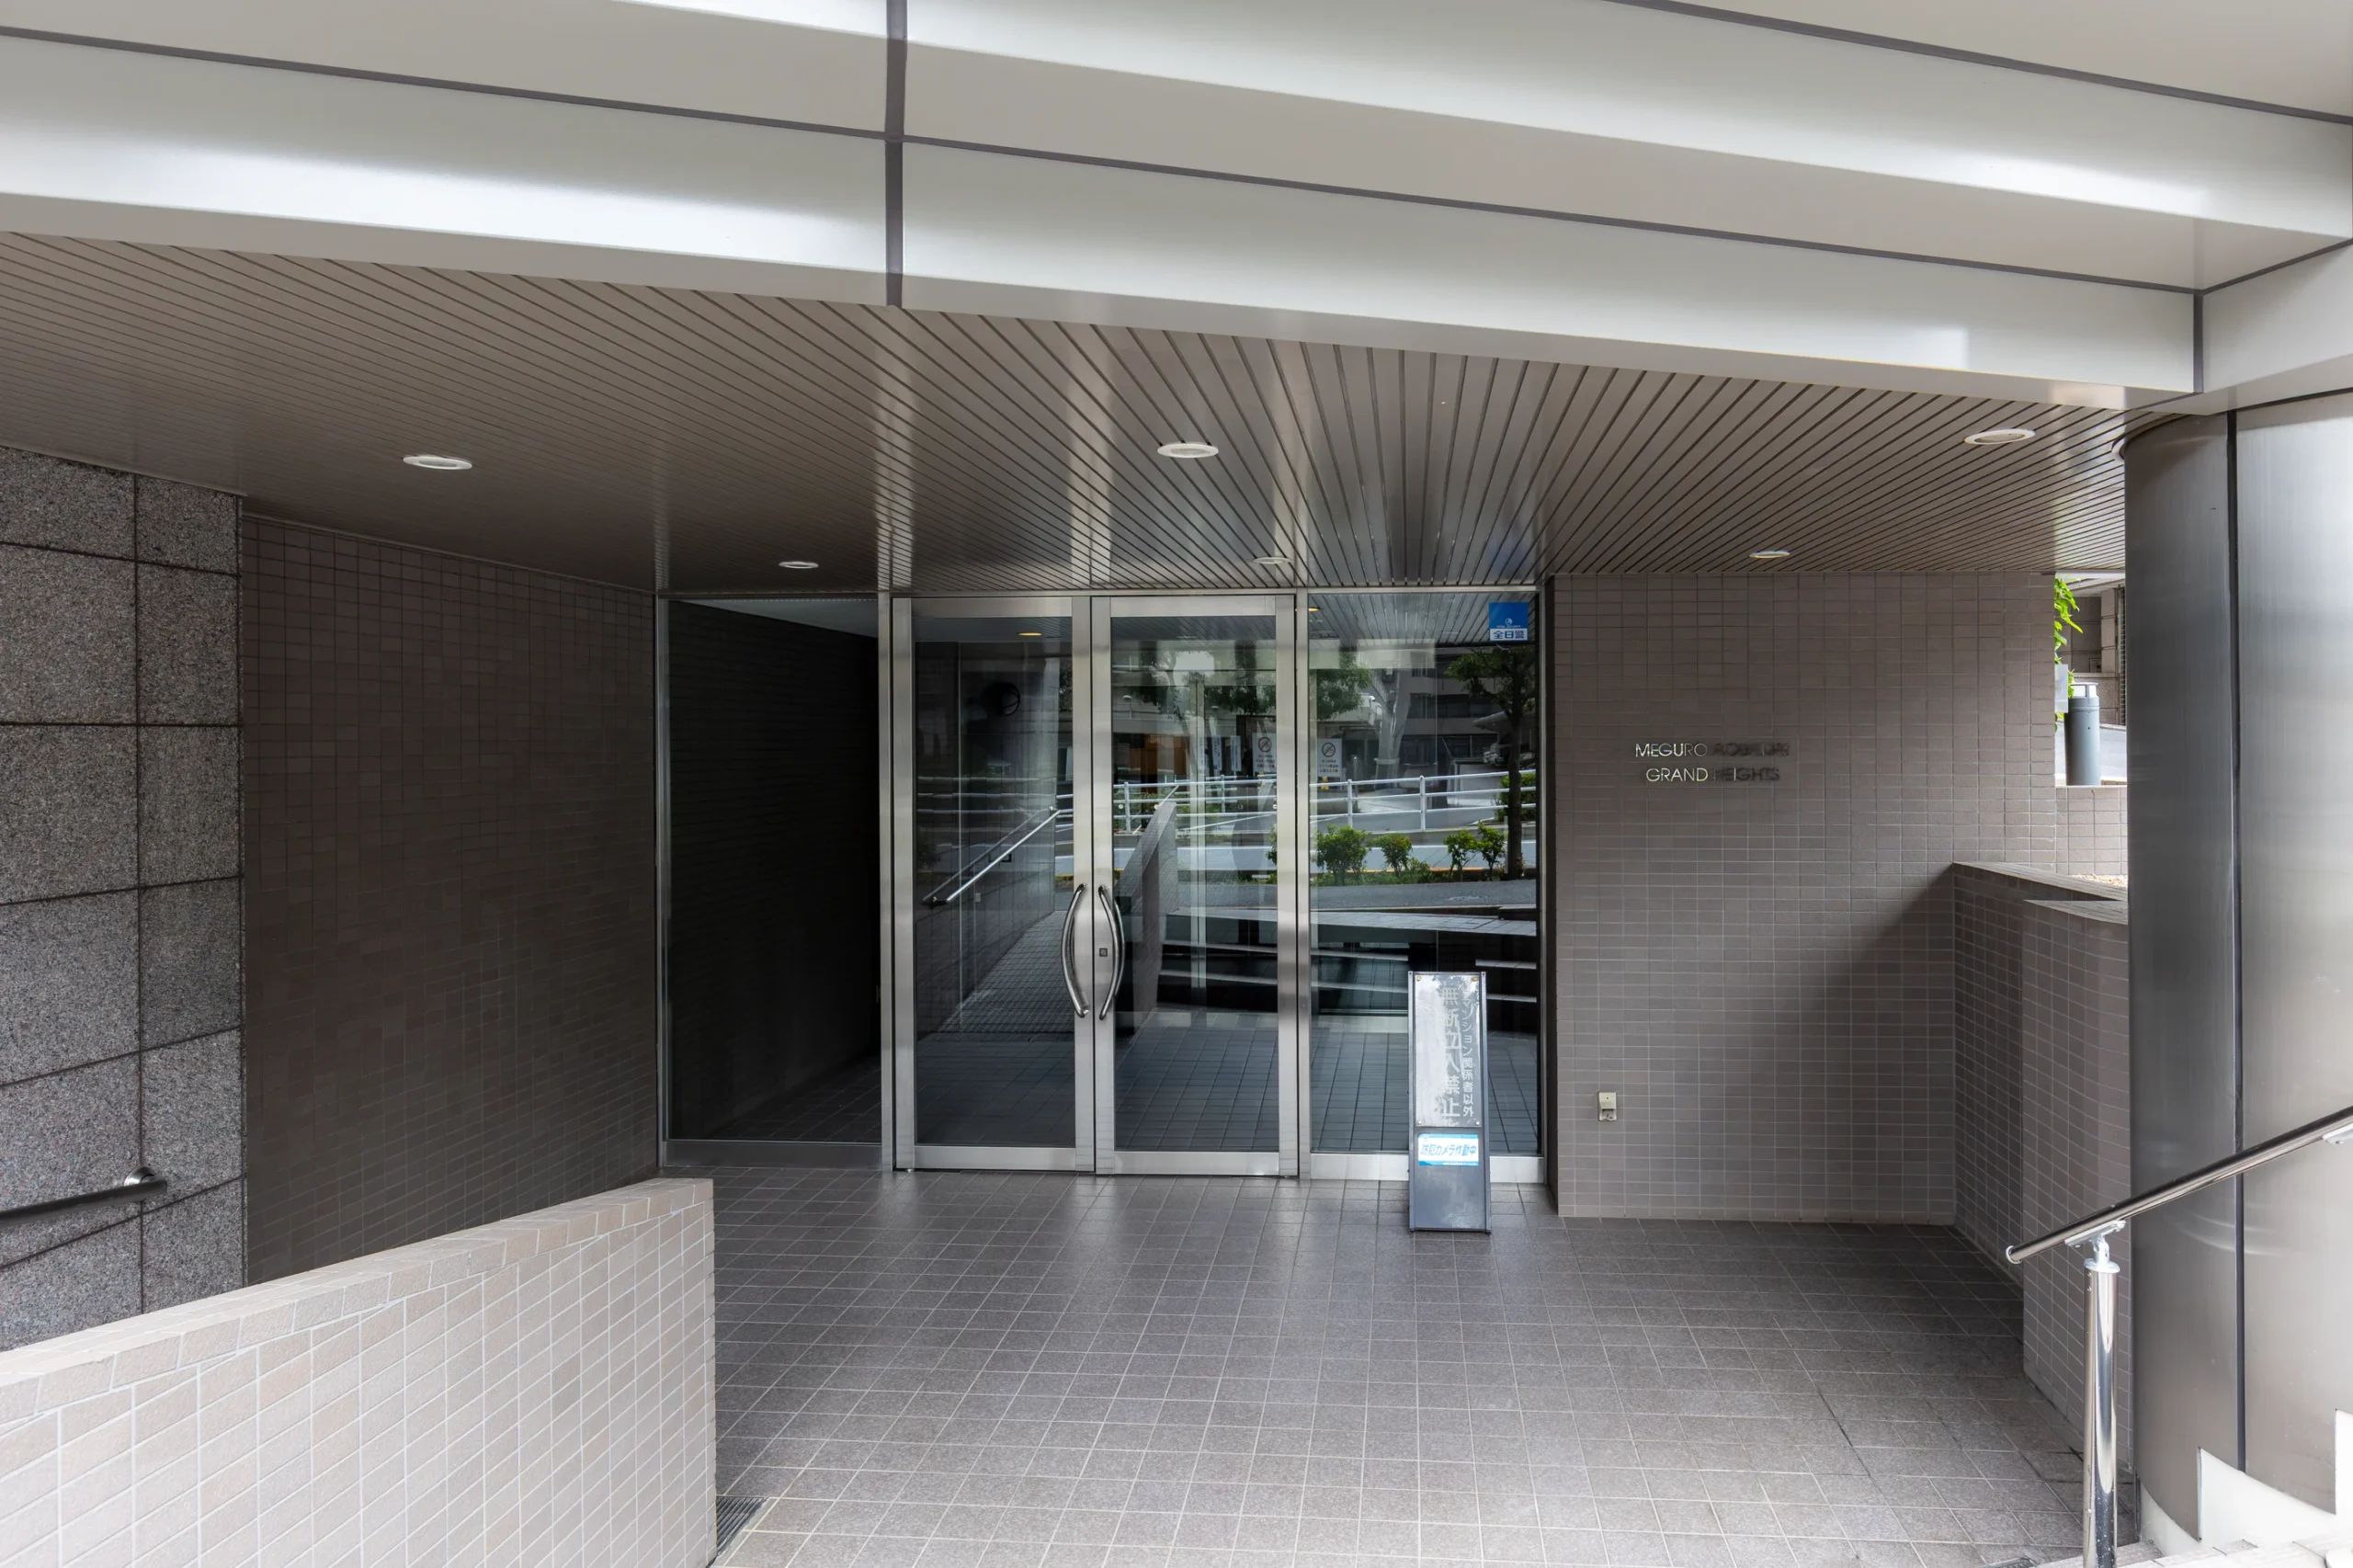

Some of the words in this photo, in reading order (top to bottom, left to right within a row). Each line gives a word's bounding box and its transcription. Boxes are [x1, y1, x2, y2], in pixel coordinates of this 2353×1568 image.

[1635, 743, 1708, 757] MEGURO
[1645, 767, 1709, 782] GRAND
[1713, 767, 1780, 782] HEIGHTS
[1441, 986, 1461, 1119] 無断立入禁止
[1420, 1143, 1478, 1158] 防犯カメラ作動中
